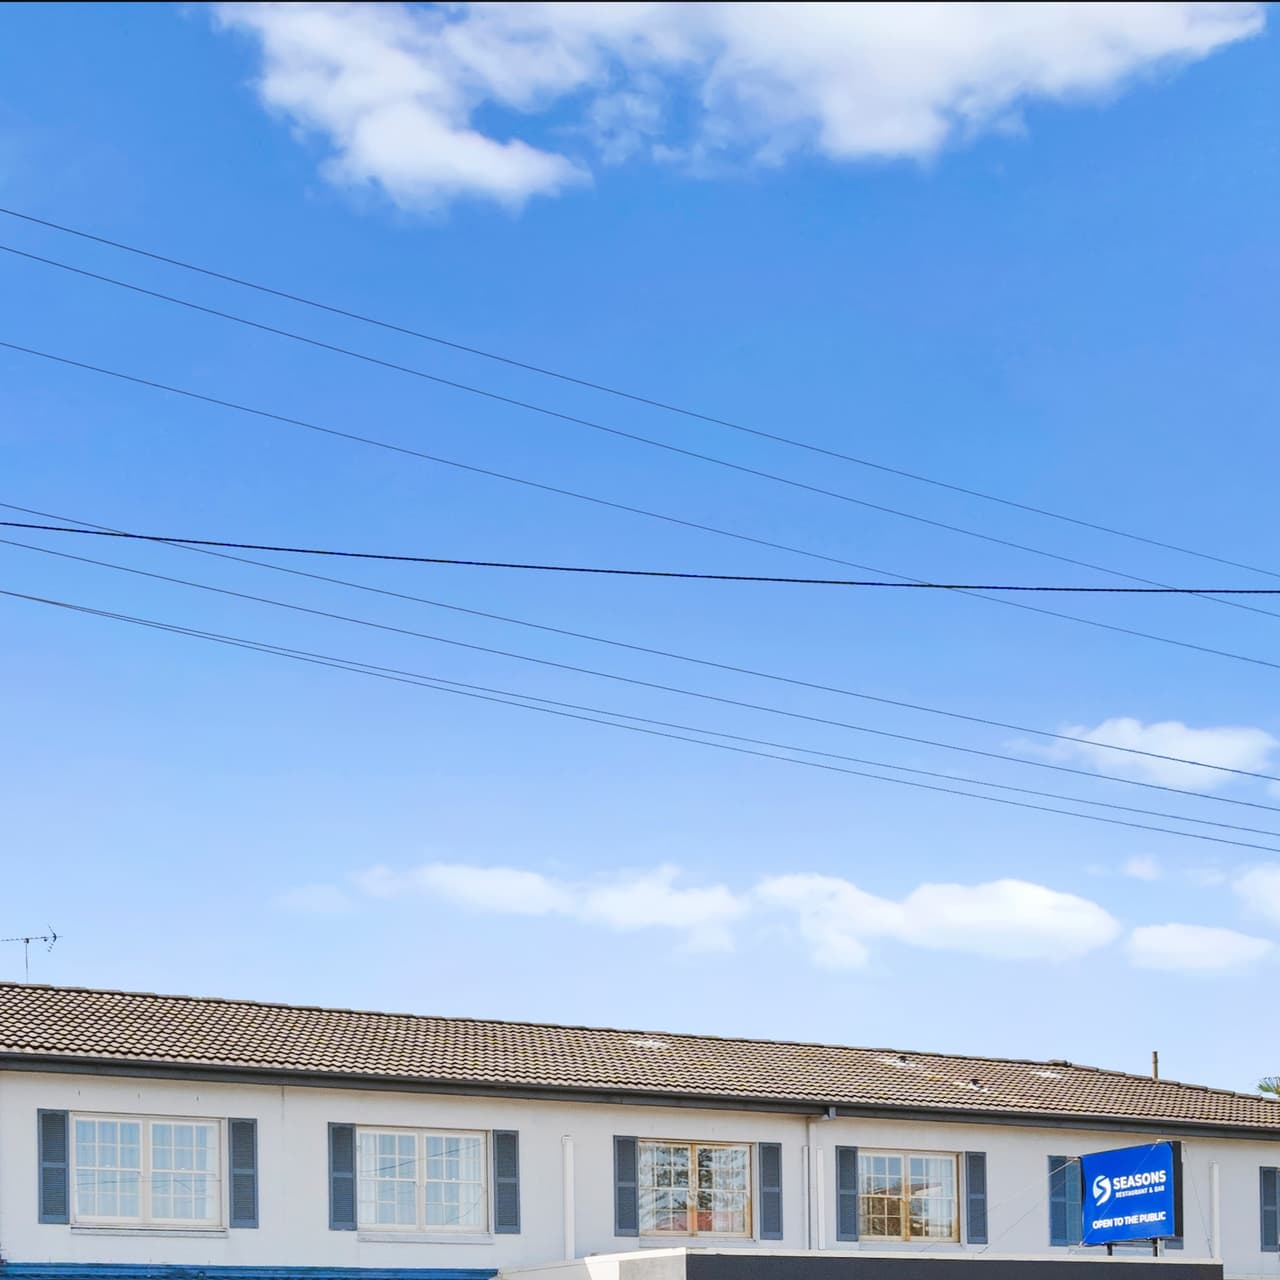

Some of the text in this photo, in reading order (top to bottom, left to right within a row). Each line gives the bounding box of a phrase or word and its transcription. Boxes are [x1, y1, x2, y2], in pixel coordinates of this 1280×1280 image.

[1113, 1170, 1166, 1190] SEASONS
[1092, 1211, 1166, 1229] OPEN TO THE PUBLIC
